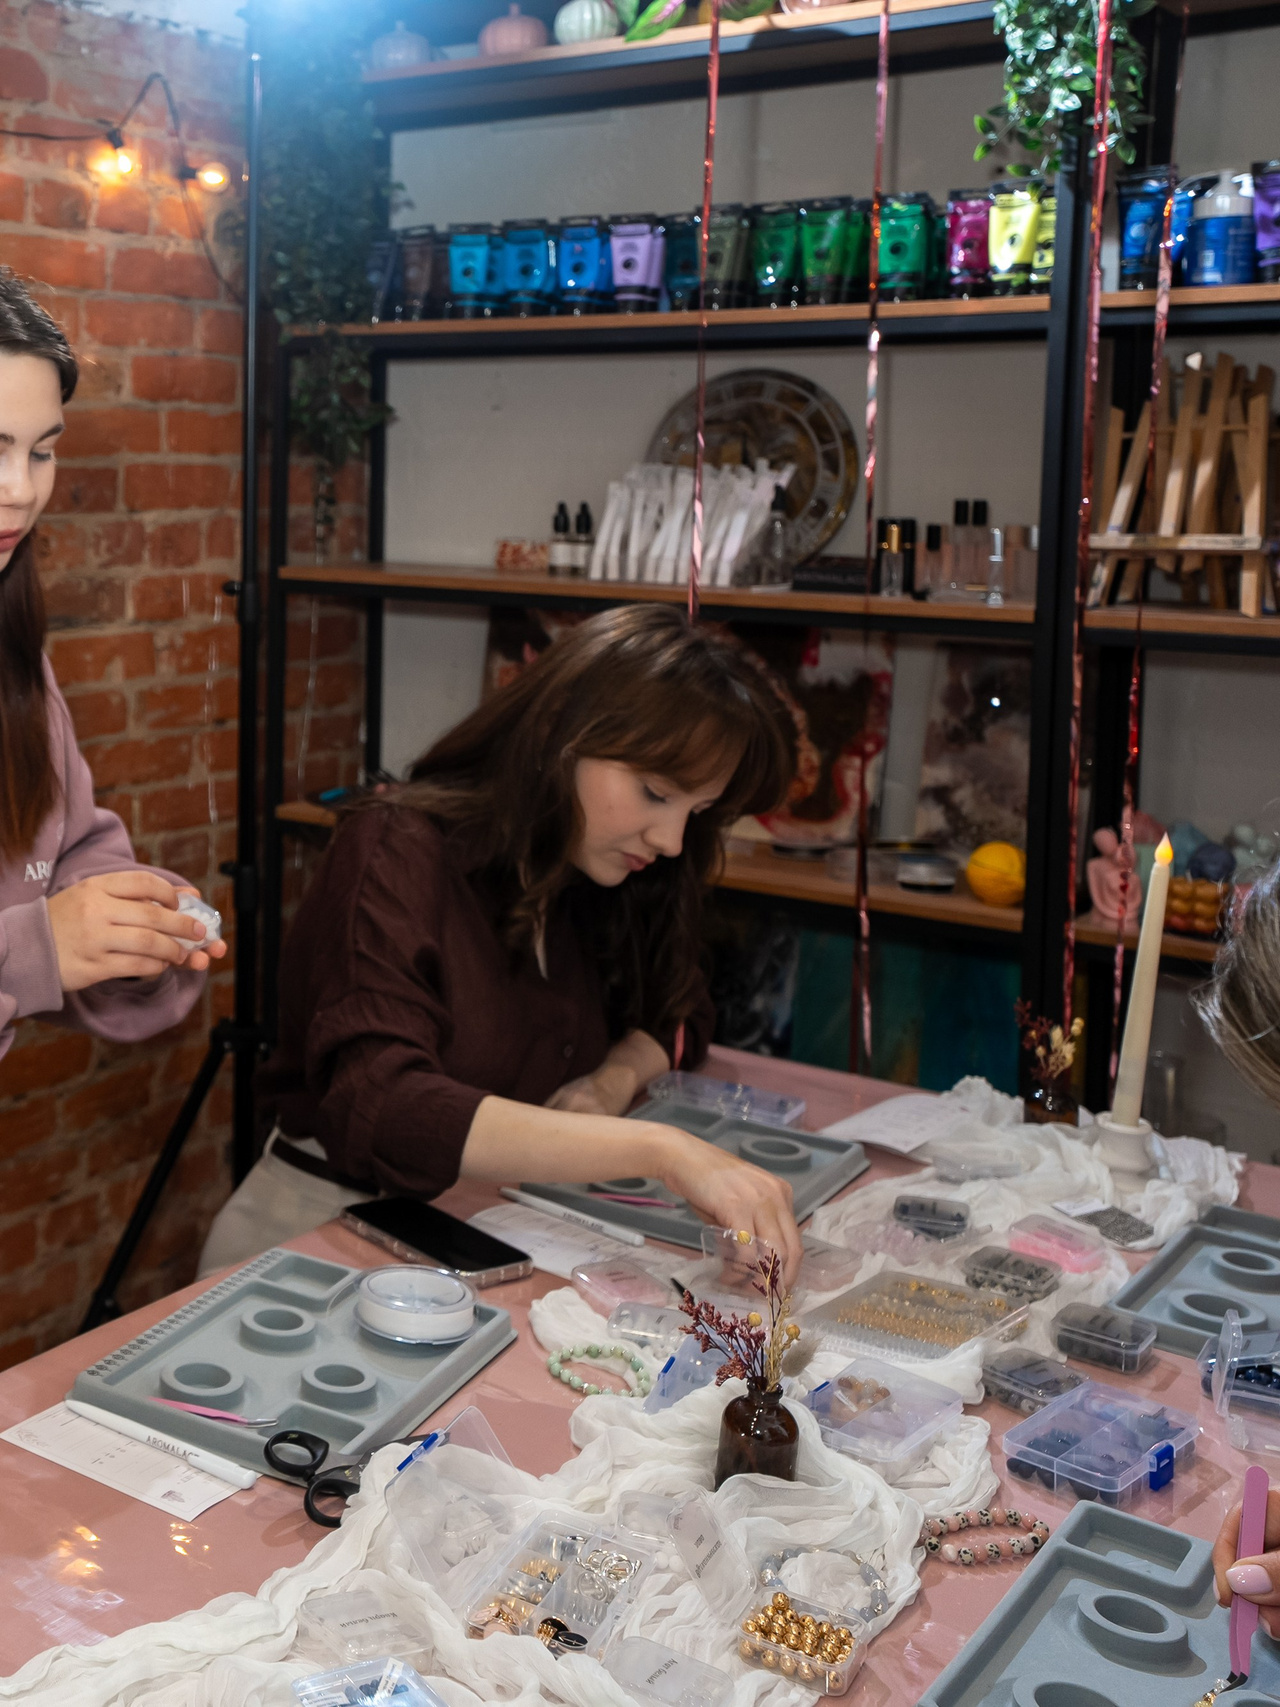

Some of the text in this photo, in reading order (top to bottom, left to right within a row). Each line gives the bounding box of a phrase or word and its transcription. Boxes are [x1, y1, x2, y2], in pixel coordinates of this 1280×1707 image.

[146, 1435, 200, 1460] AROMALA
[339, 1612, 398, 1628] Кварц белый
